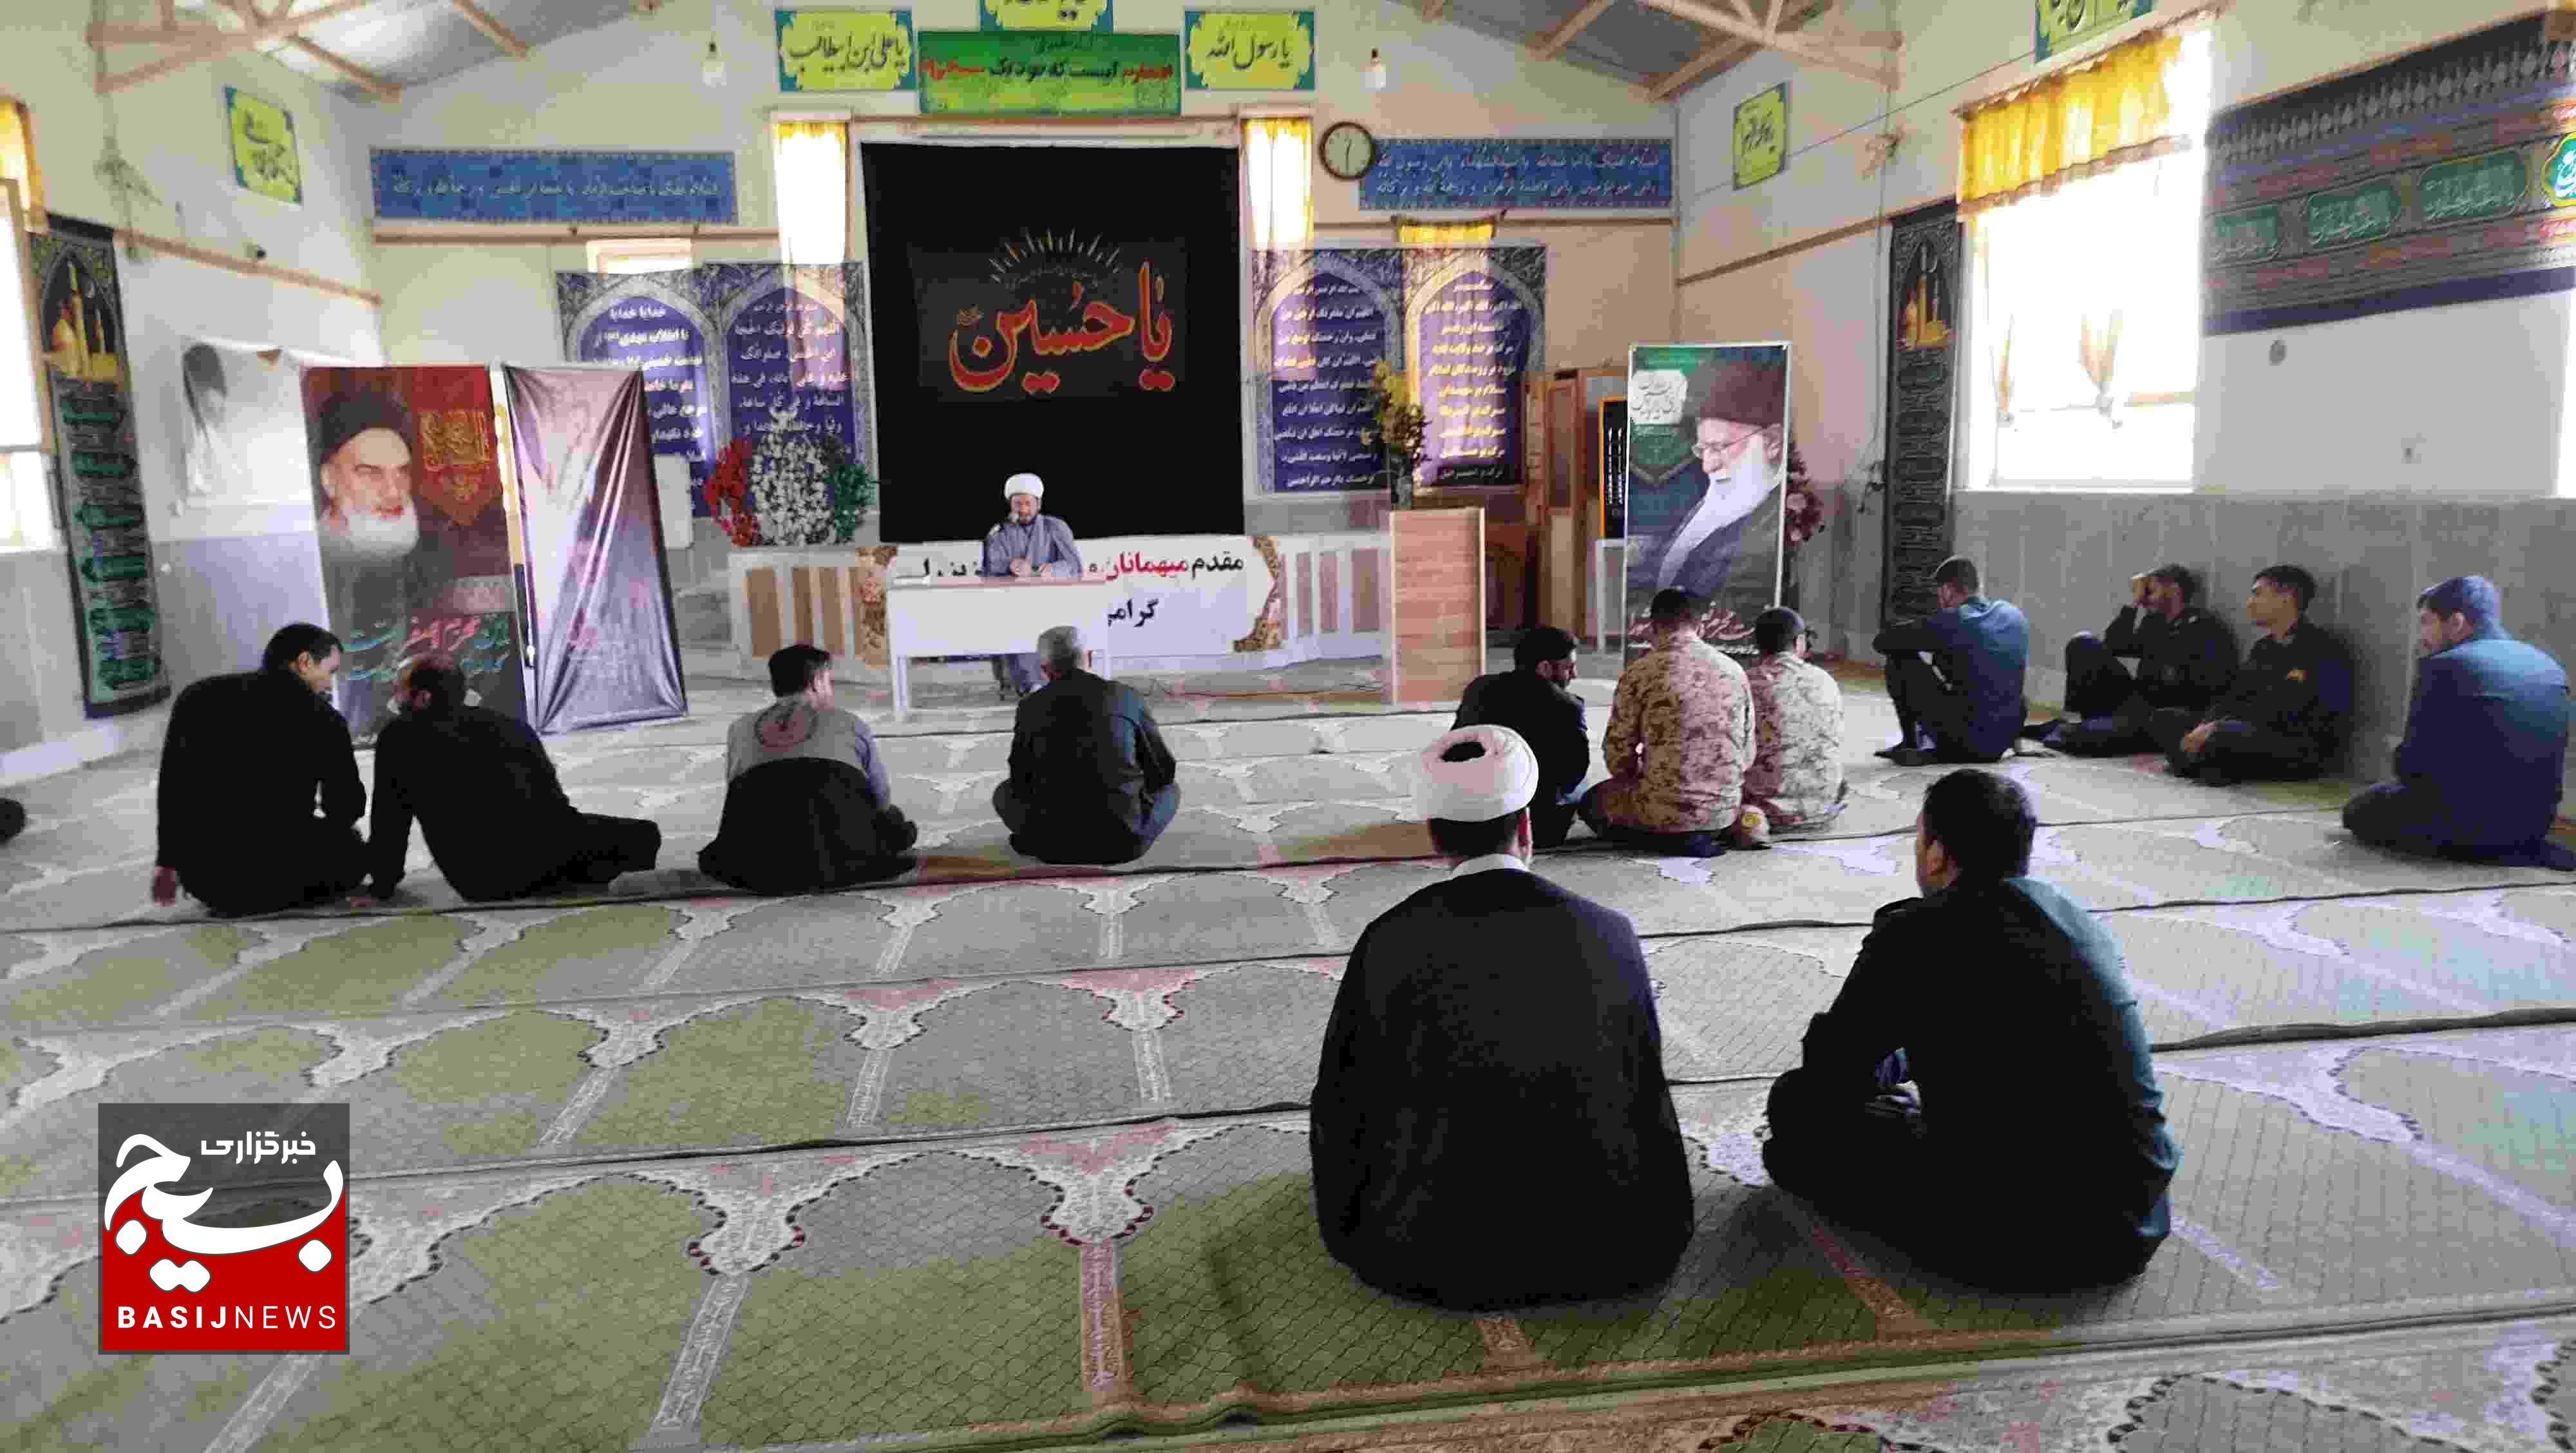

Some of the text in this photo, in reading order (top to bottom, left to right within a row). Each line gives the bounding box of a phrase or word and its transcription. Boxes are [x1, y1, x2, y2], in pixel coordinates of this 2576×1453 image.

[948, 258, 1175, 392] یا حسین
[1191, 549, 1244, 574] مقدم
